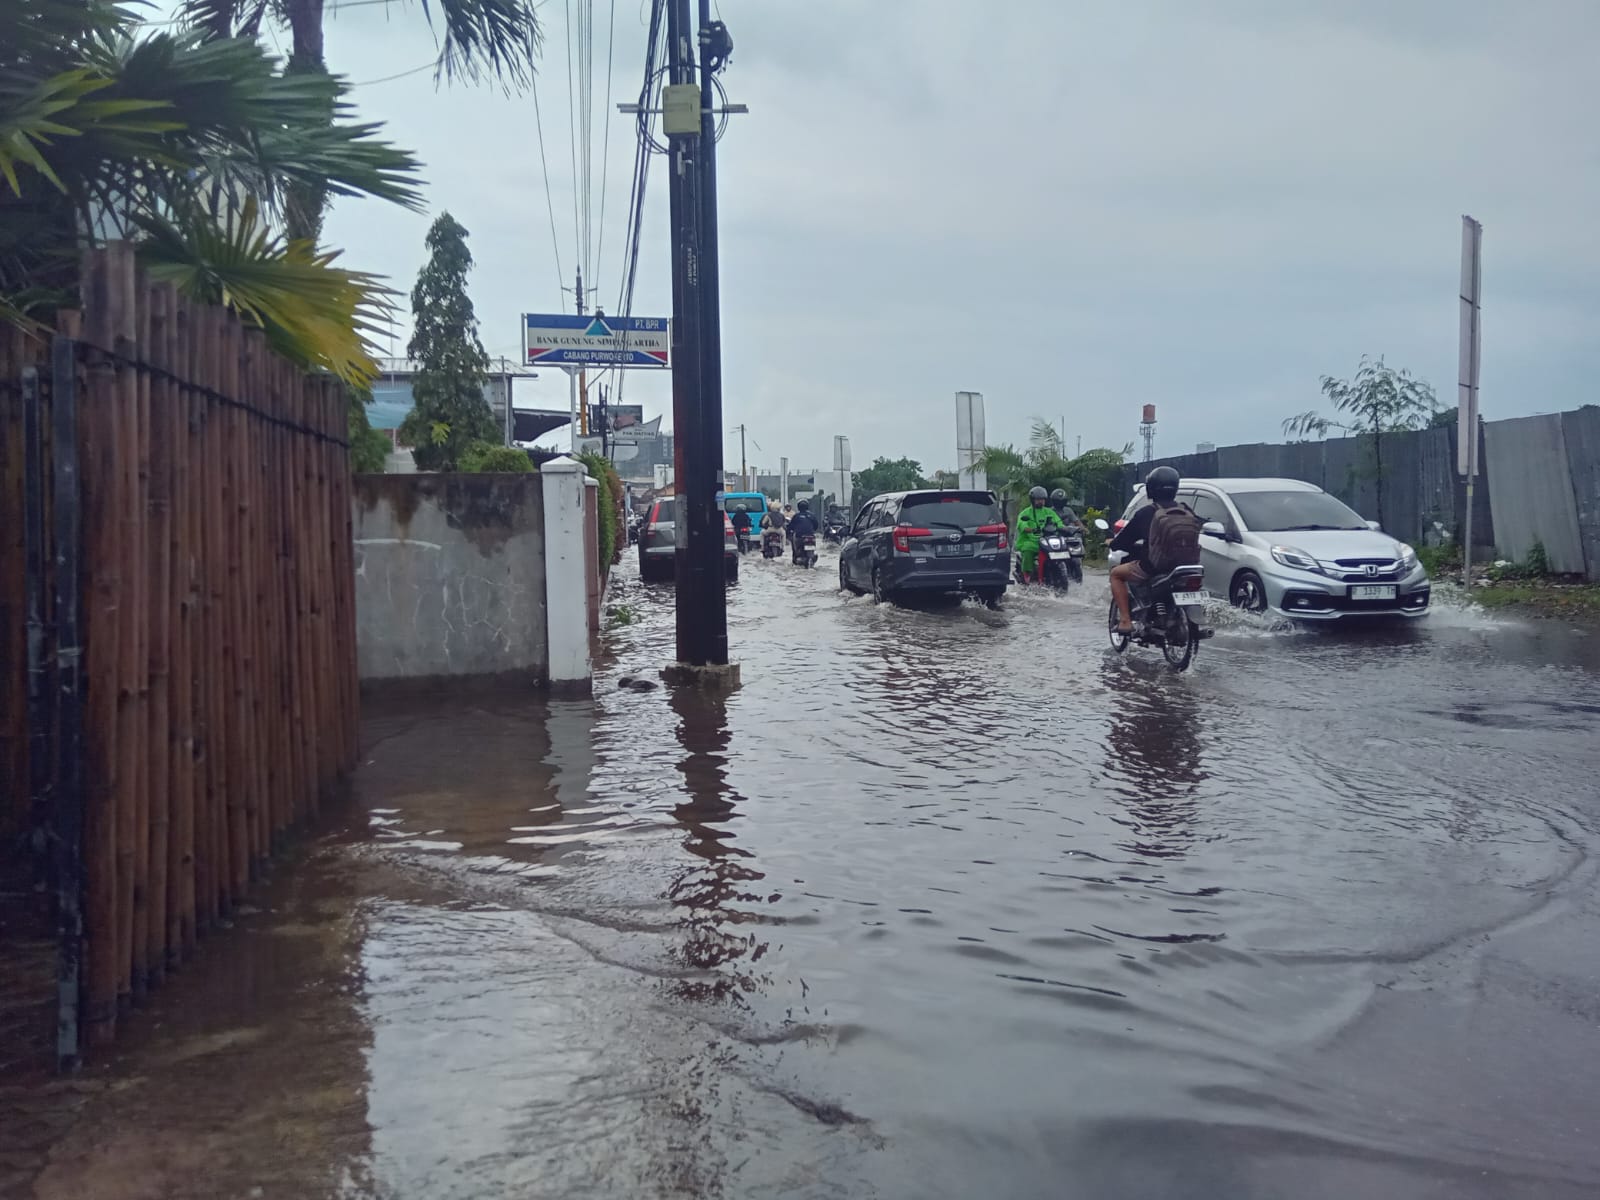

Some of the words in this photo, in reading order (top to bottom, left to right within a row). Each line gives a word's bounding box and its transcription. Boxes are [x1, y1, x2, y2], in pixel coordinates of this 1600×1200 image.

[635, 319, 645, 329] PT.
[646, 319, 660, 329] BPR
[536, 336, 559, 345] BANK
[560, 336, 595, 346] GUNUNG
[634, 338, 660, 348] ARTHA
